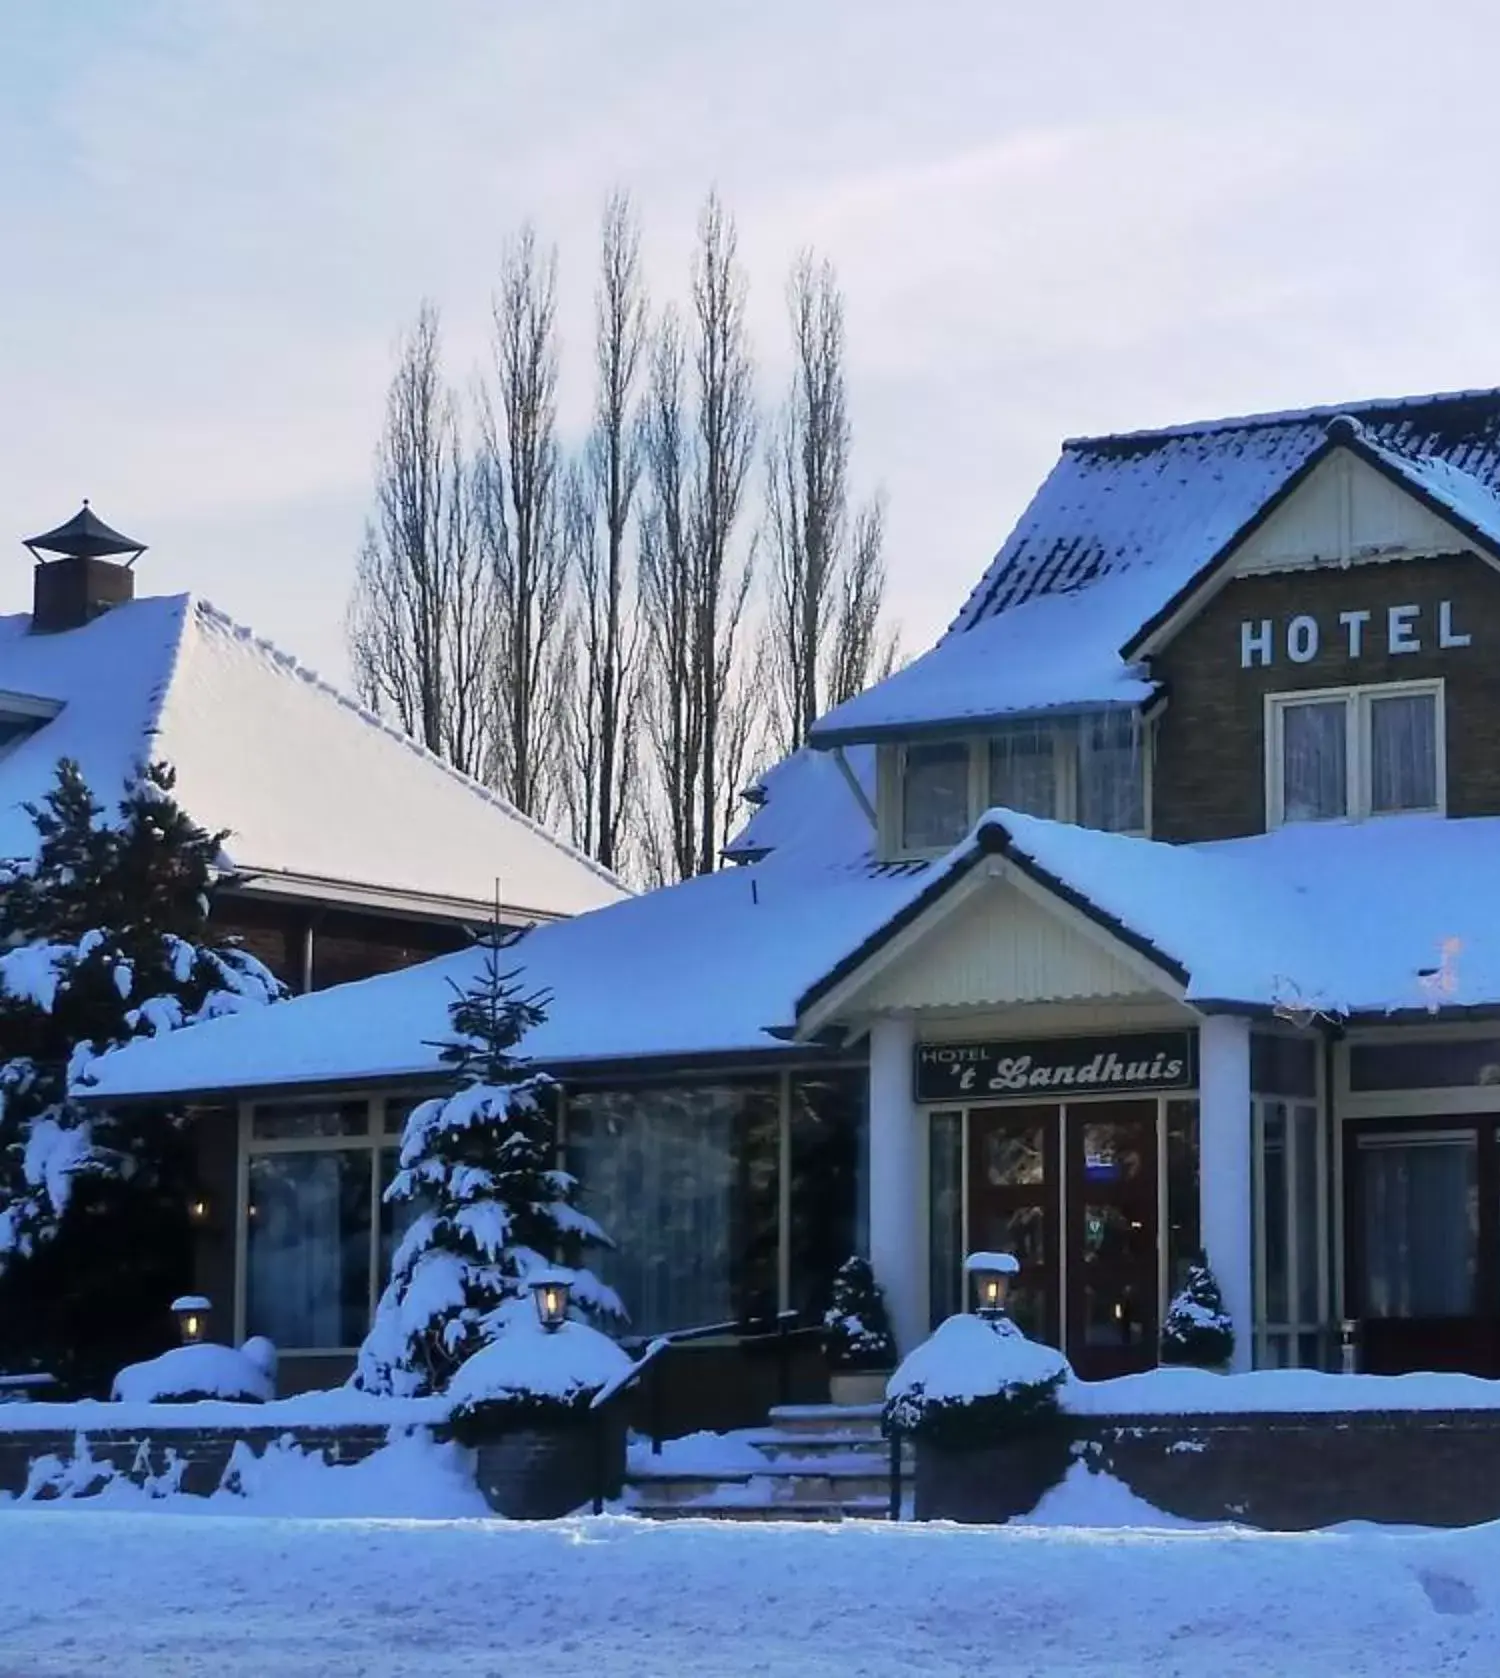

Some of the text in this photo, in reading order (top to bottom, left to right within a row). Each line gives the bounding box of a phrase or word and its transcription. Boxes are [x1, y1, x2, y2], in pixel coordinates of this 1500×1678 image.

[1240, 600, 1472, 668] HOTEL
[921, 1047, 991, 1064] HOTEL
[988, 1052, 1184, 1089] Landhuis
